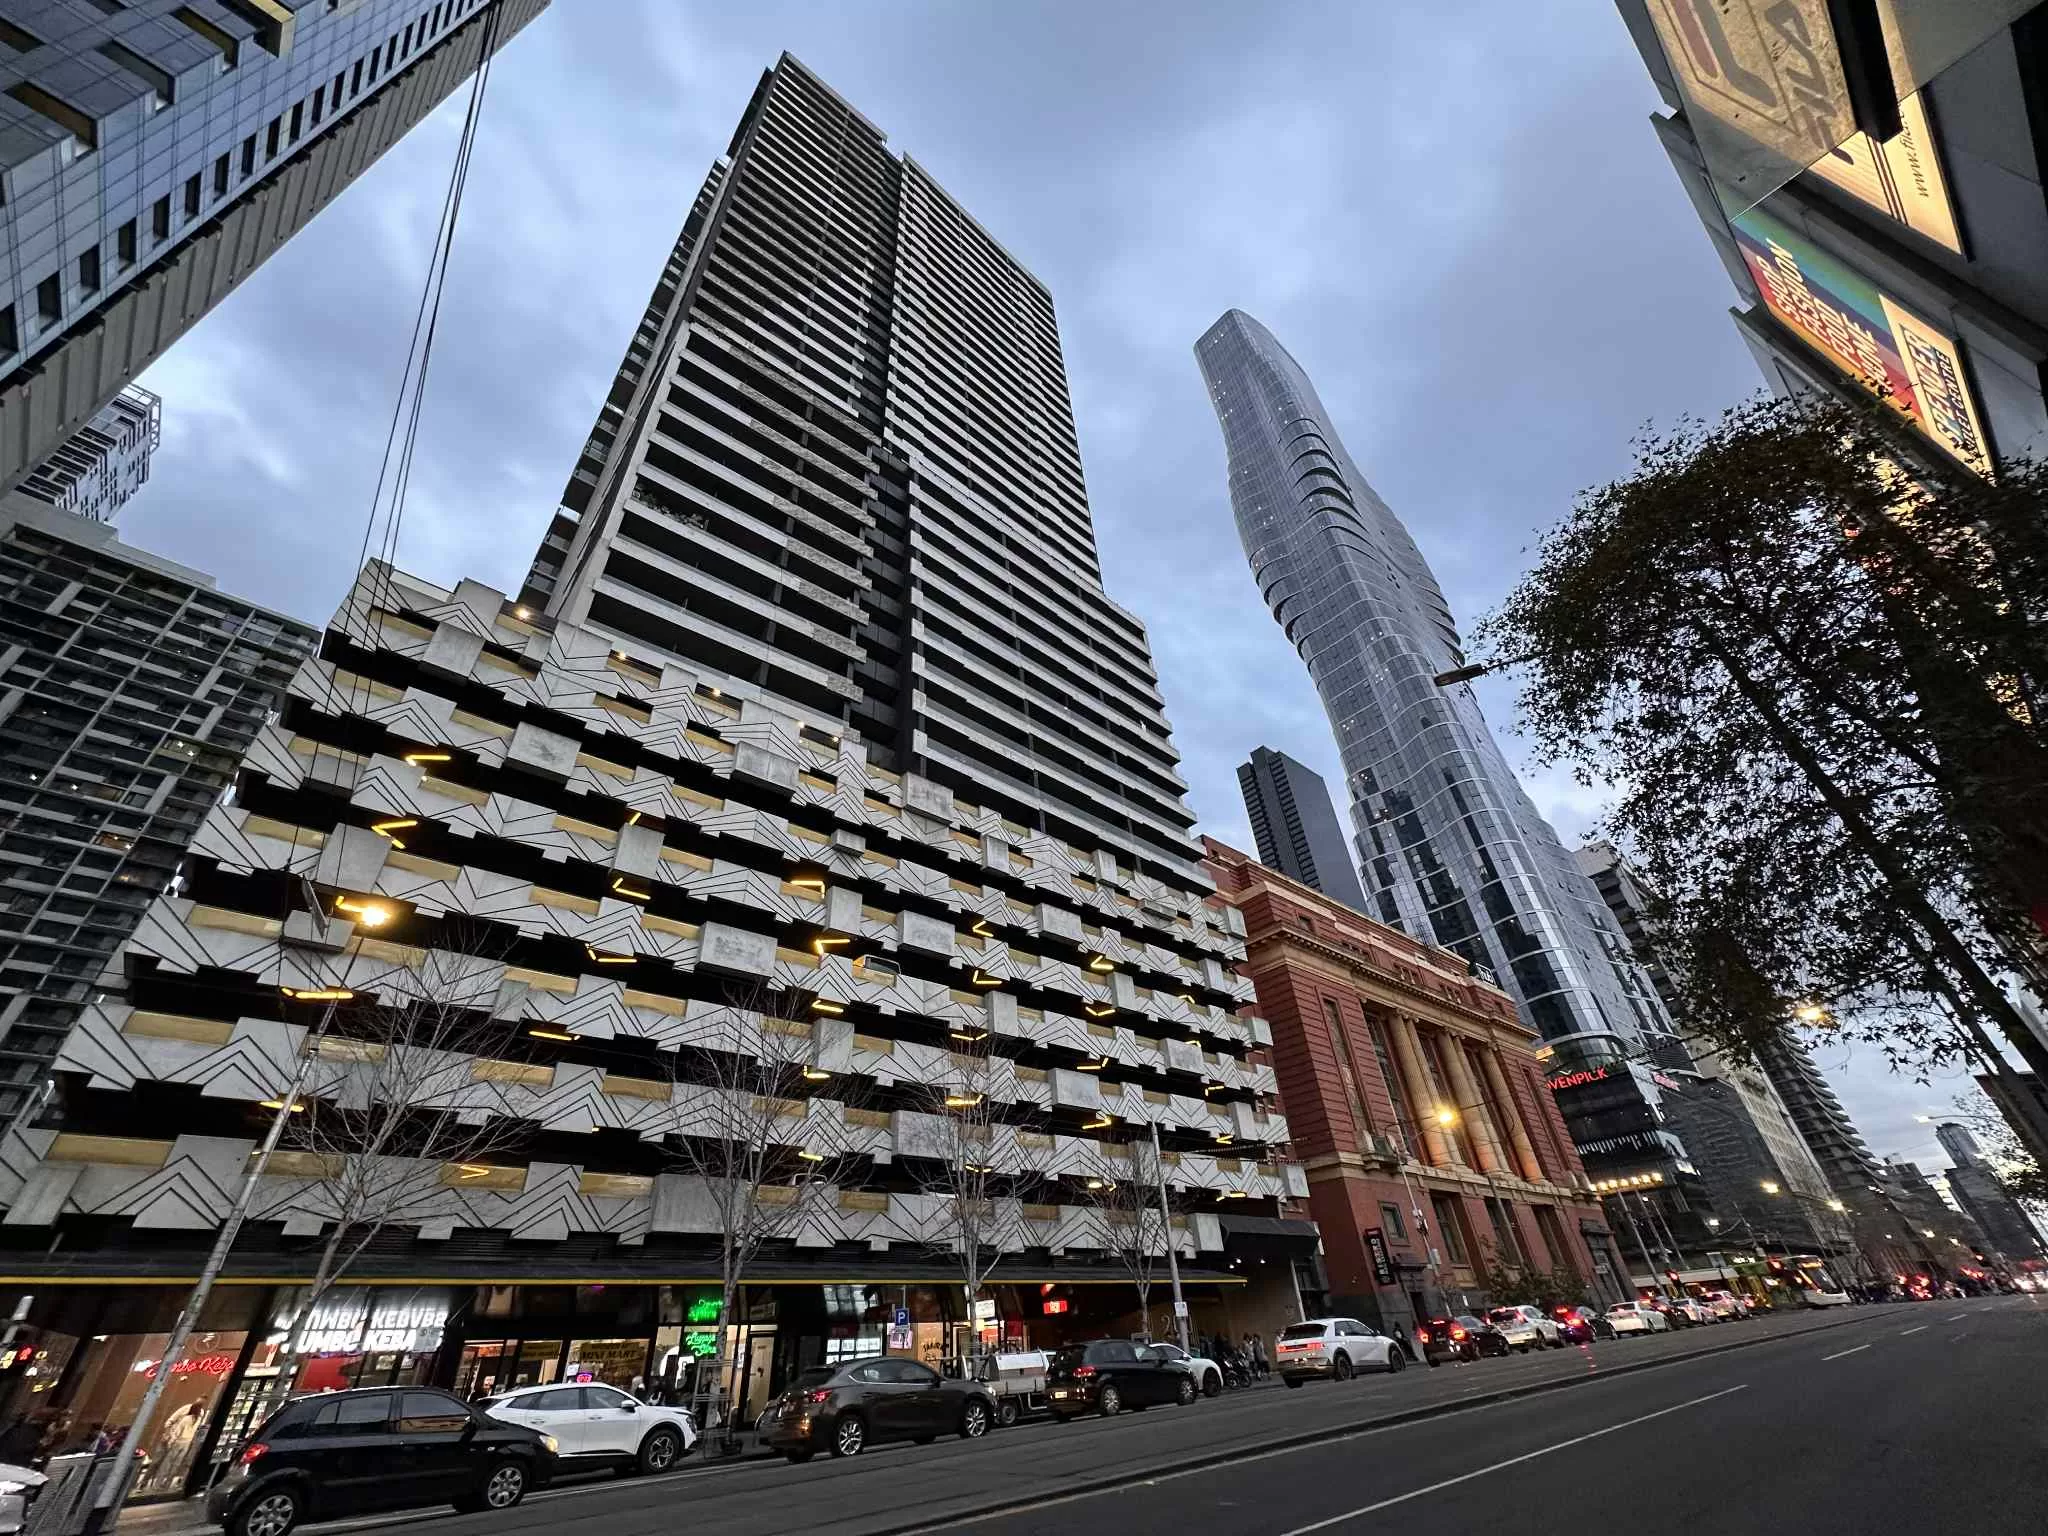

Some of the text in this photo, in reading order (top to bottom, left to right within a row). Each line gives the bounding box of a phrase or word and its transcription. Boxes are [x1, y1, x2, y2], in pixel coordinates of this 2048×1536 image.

[1757, 255, 1801, 322] SHOP
[1766, 237, 1831, 345] FASHION
[1813, 297, 1861, 369] FOOD
[1841, 312, 1894, 393] HOME
[1904, 329, 1963, 445] SPENCER
[1936, 350, 1966, 410] CENTRE
